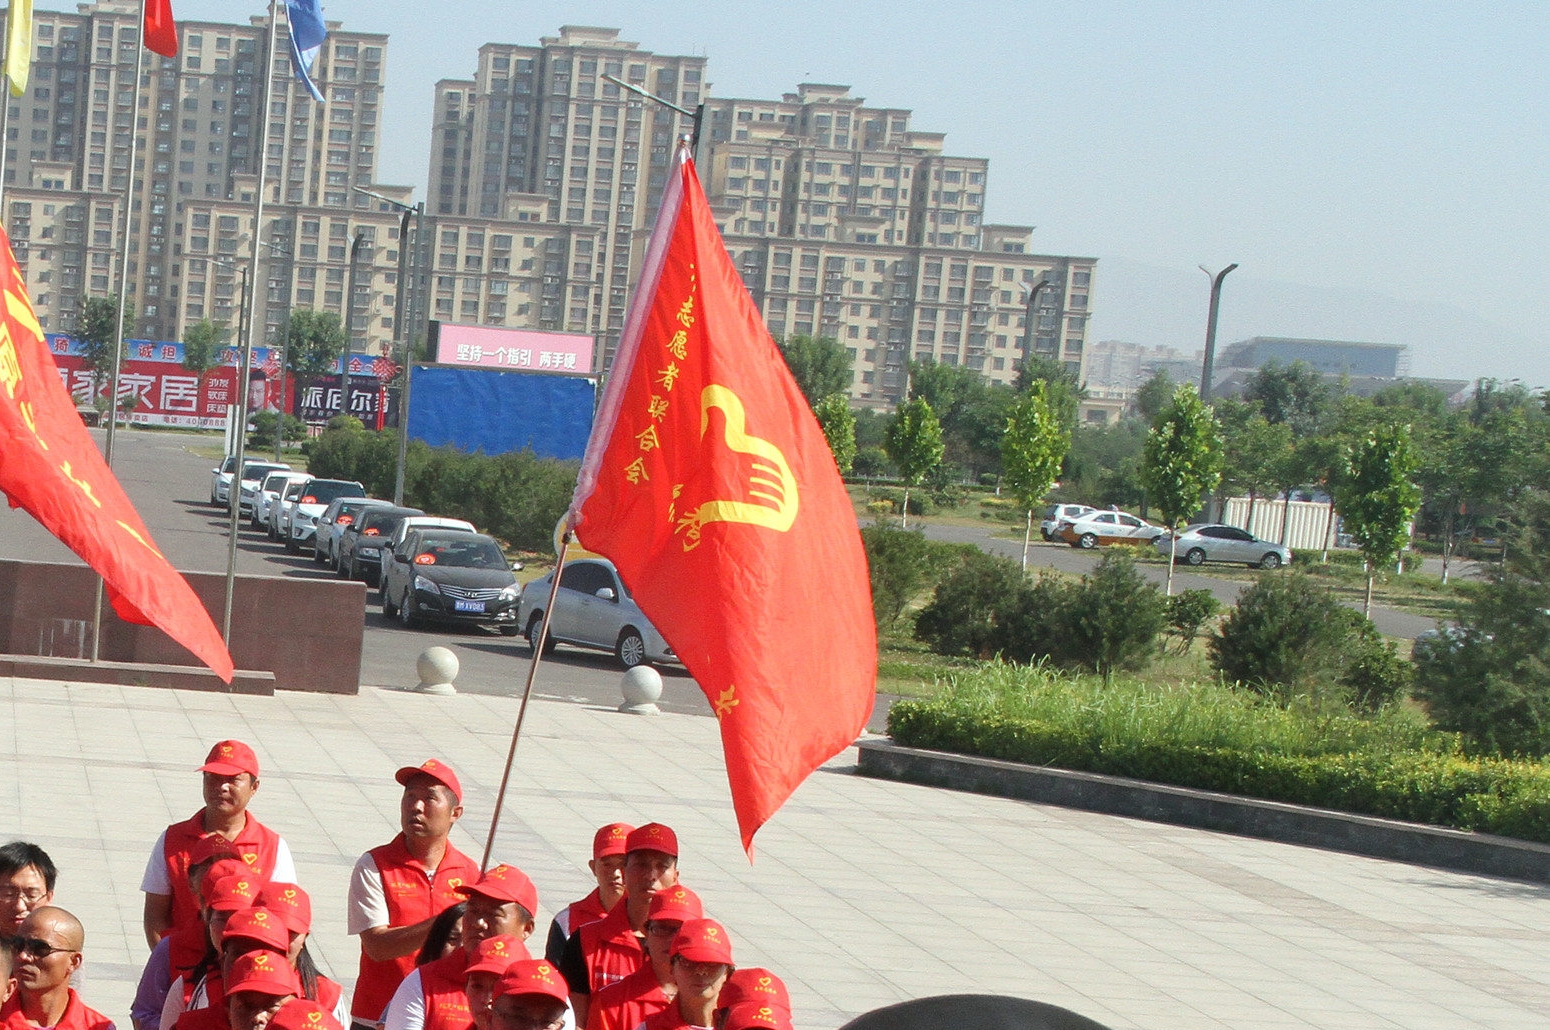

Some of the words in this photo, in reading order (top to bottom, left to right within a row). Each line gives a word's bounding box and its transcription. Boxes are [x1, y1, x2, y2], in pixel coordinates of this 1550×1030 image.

[456, 344, 532, 367] 坚持一个指引
[539, 351, 577, 370] 两手硬
[624, 263, 696, 485] 志愿者联合会
